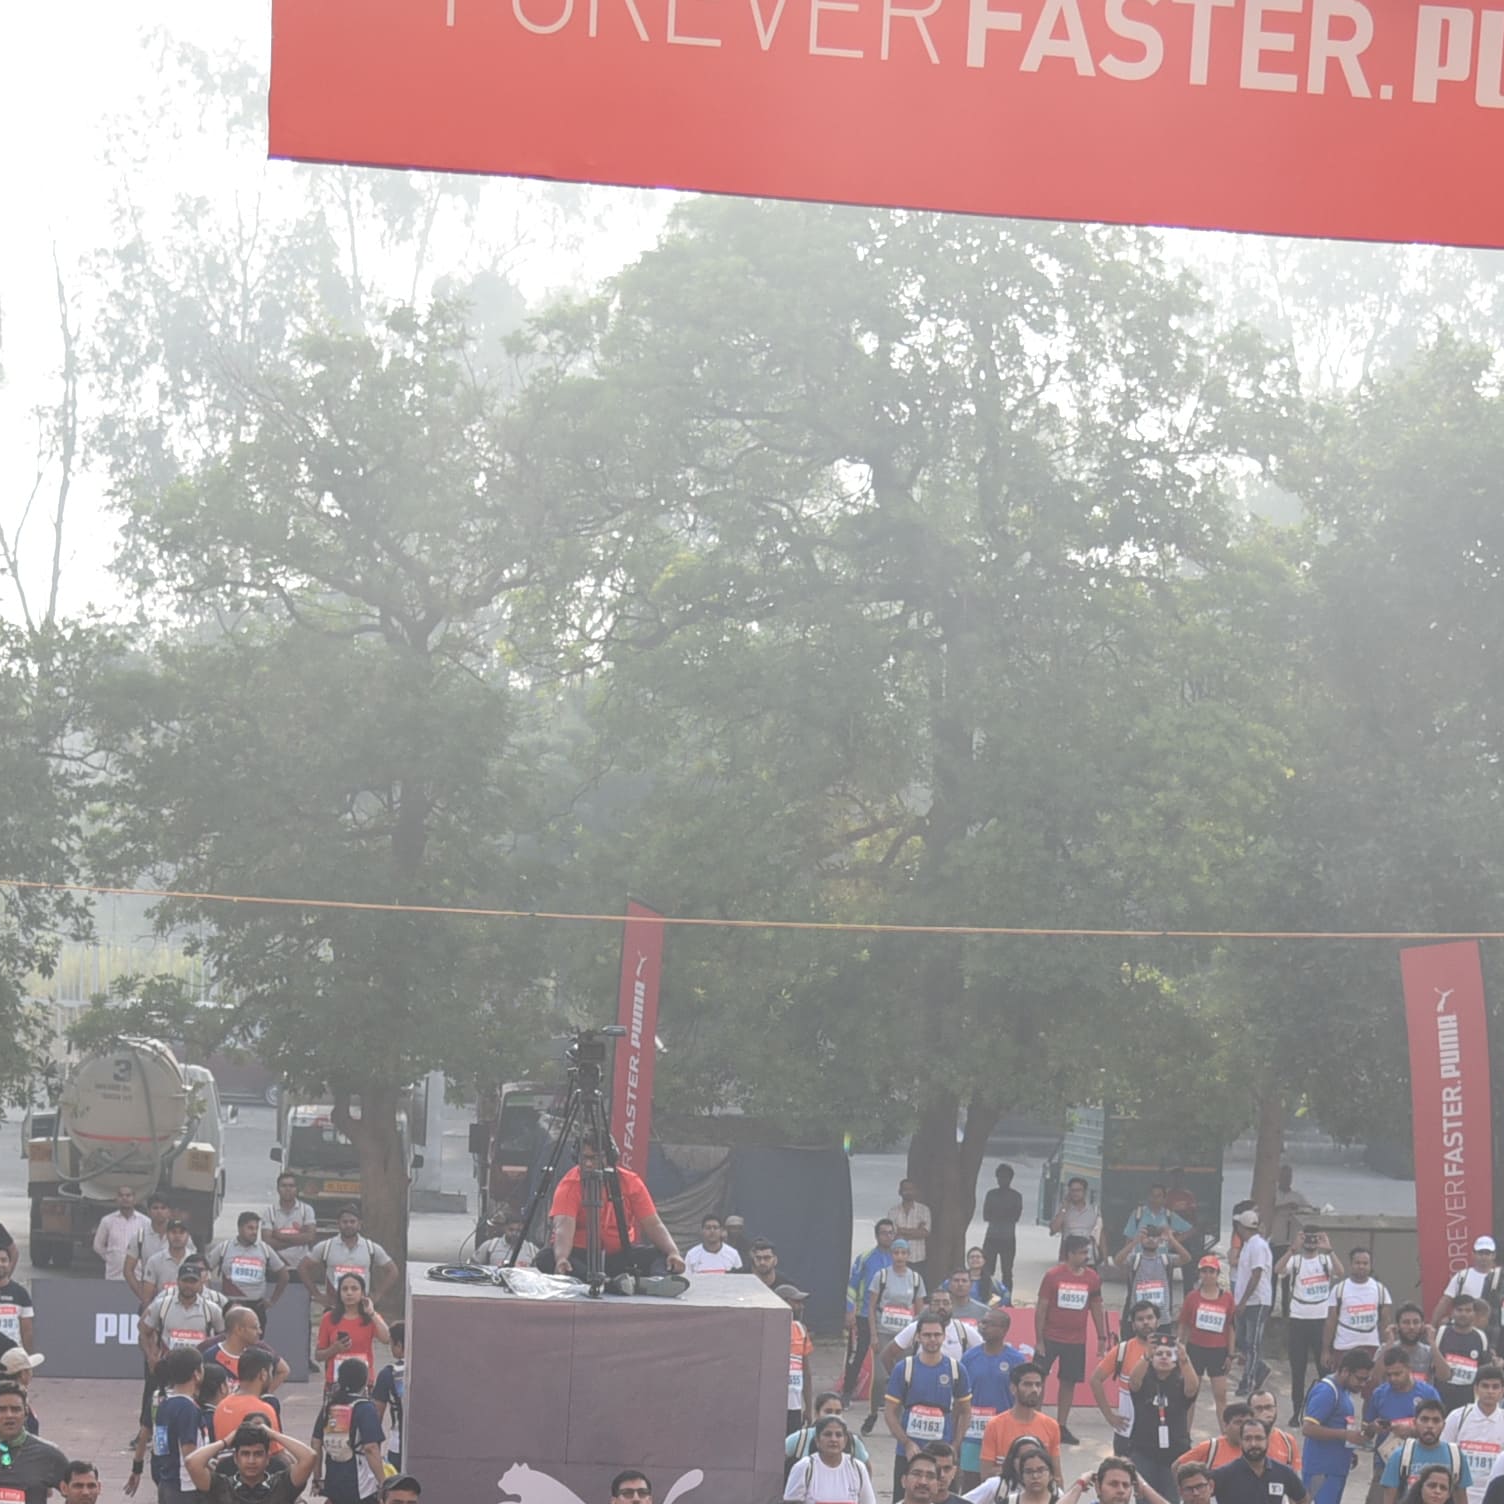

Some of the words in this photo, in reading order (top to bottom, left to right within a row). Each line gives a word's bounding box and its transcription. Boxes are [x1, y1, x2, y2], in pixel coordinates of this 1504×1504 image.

[966, 0, 1393, 100] FASTER.
[630, 980, 645, 1050] PUMA
[1437, 1013, 1461, 1079] PUMA
[1445, 1180, 1468, 1283] OREVER
[95, 1312, 139, 1345] PU
